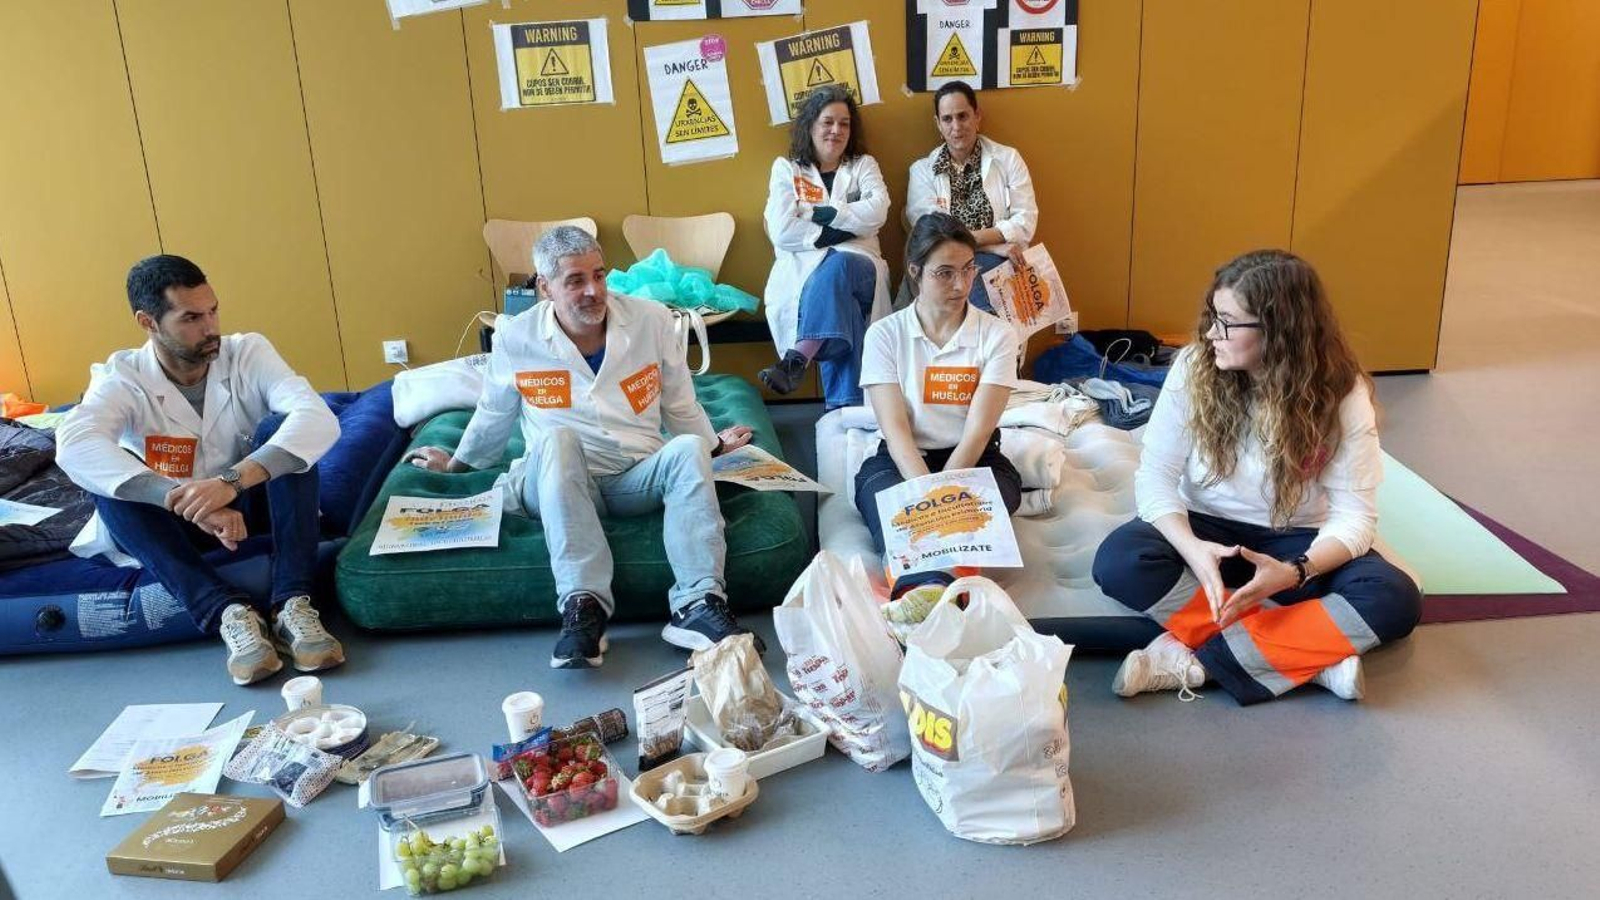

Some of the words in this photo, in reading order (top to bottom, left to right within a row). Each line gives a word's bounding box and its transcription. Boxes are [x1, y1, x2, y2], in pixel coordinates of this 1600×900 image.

[939, 20, 971, 29] DANGER
[525, 26, 578, 44] WARNING
[1019, 31, 1055, 43] WARNING
[788, 32, 841, 57] WARNING
[664, 59, 709, 75] DANGER
[1026, 265, 1045, 312] FOLGA
[627, 368, 659, 392] MÉDICO
[948, 383, 958, 391] EN
[931, 391, 972, 401] HUELGA
[904, 491, 973, 517] FOLGA
[921, 544, 993, 560] MOBILIZATE
[150, 749, 208, 764] FOLGA
